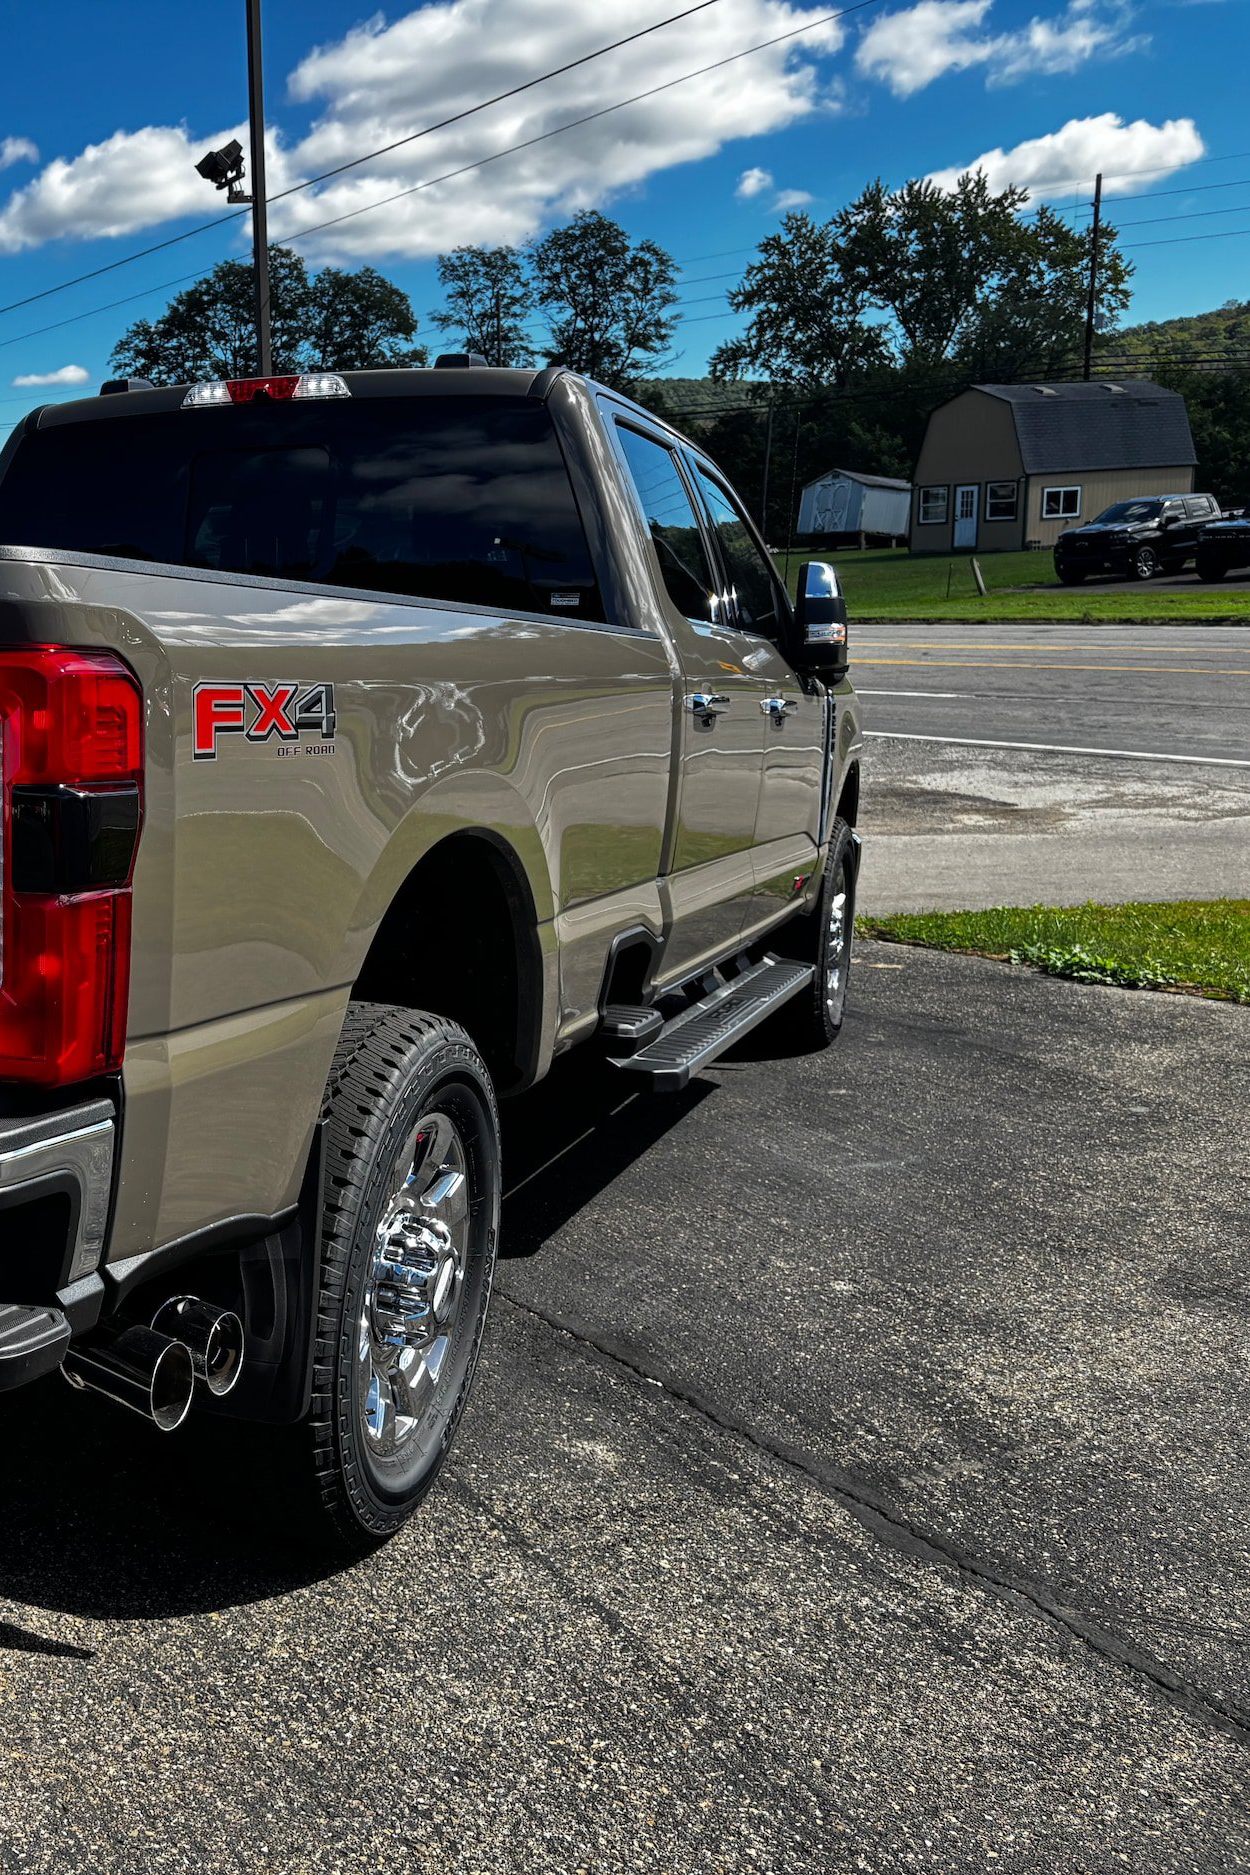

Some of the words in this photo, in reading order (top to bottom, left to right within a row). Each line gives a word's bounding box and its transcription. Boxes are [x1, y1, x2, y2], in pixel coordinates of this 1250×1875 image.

[192, 680, 337, 762] FX4
[277, 746, 301, 757] OFF
[305, 745, 335, 756] ROAD
